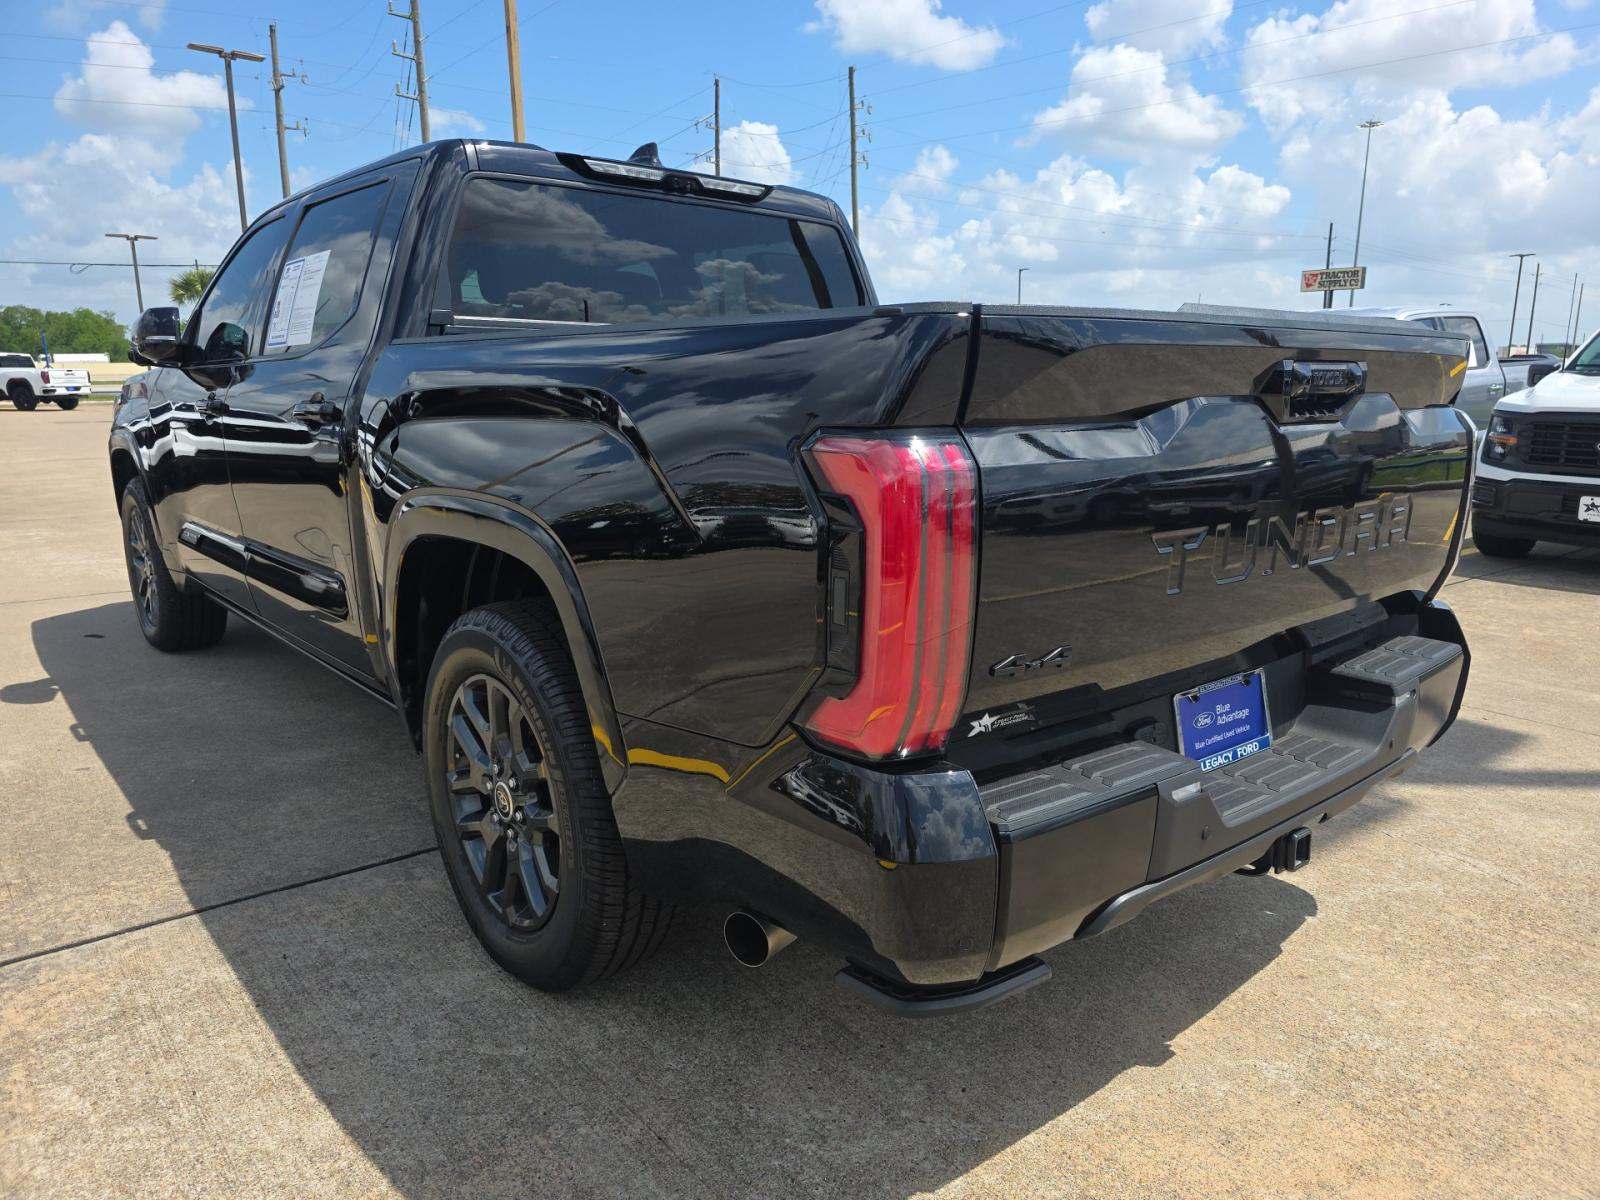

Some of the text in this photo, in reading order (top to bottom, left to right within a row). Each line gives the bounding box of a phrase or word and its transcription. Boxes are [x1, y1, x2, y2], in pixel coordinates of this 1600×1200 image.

[1320, 270, 1359, 280] TRACTOR
[1318, 280, 1348, 289] SUPPLY
[1151, 492, 1414, 596] TUNDRA
[1216, 703, 1230, 715] Blue
[1216, 707, 1250, 726] Advantage
[1196, 712, 1213, 728] Ford
[1195, 723, 1250, 750] Blue Certified Used Vehicle
[1201, 742, 1259, 772] LEGACY FORD
